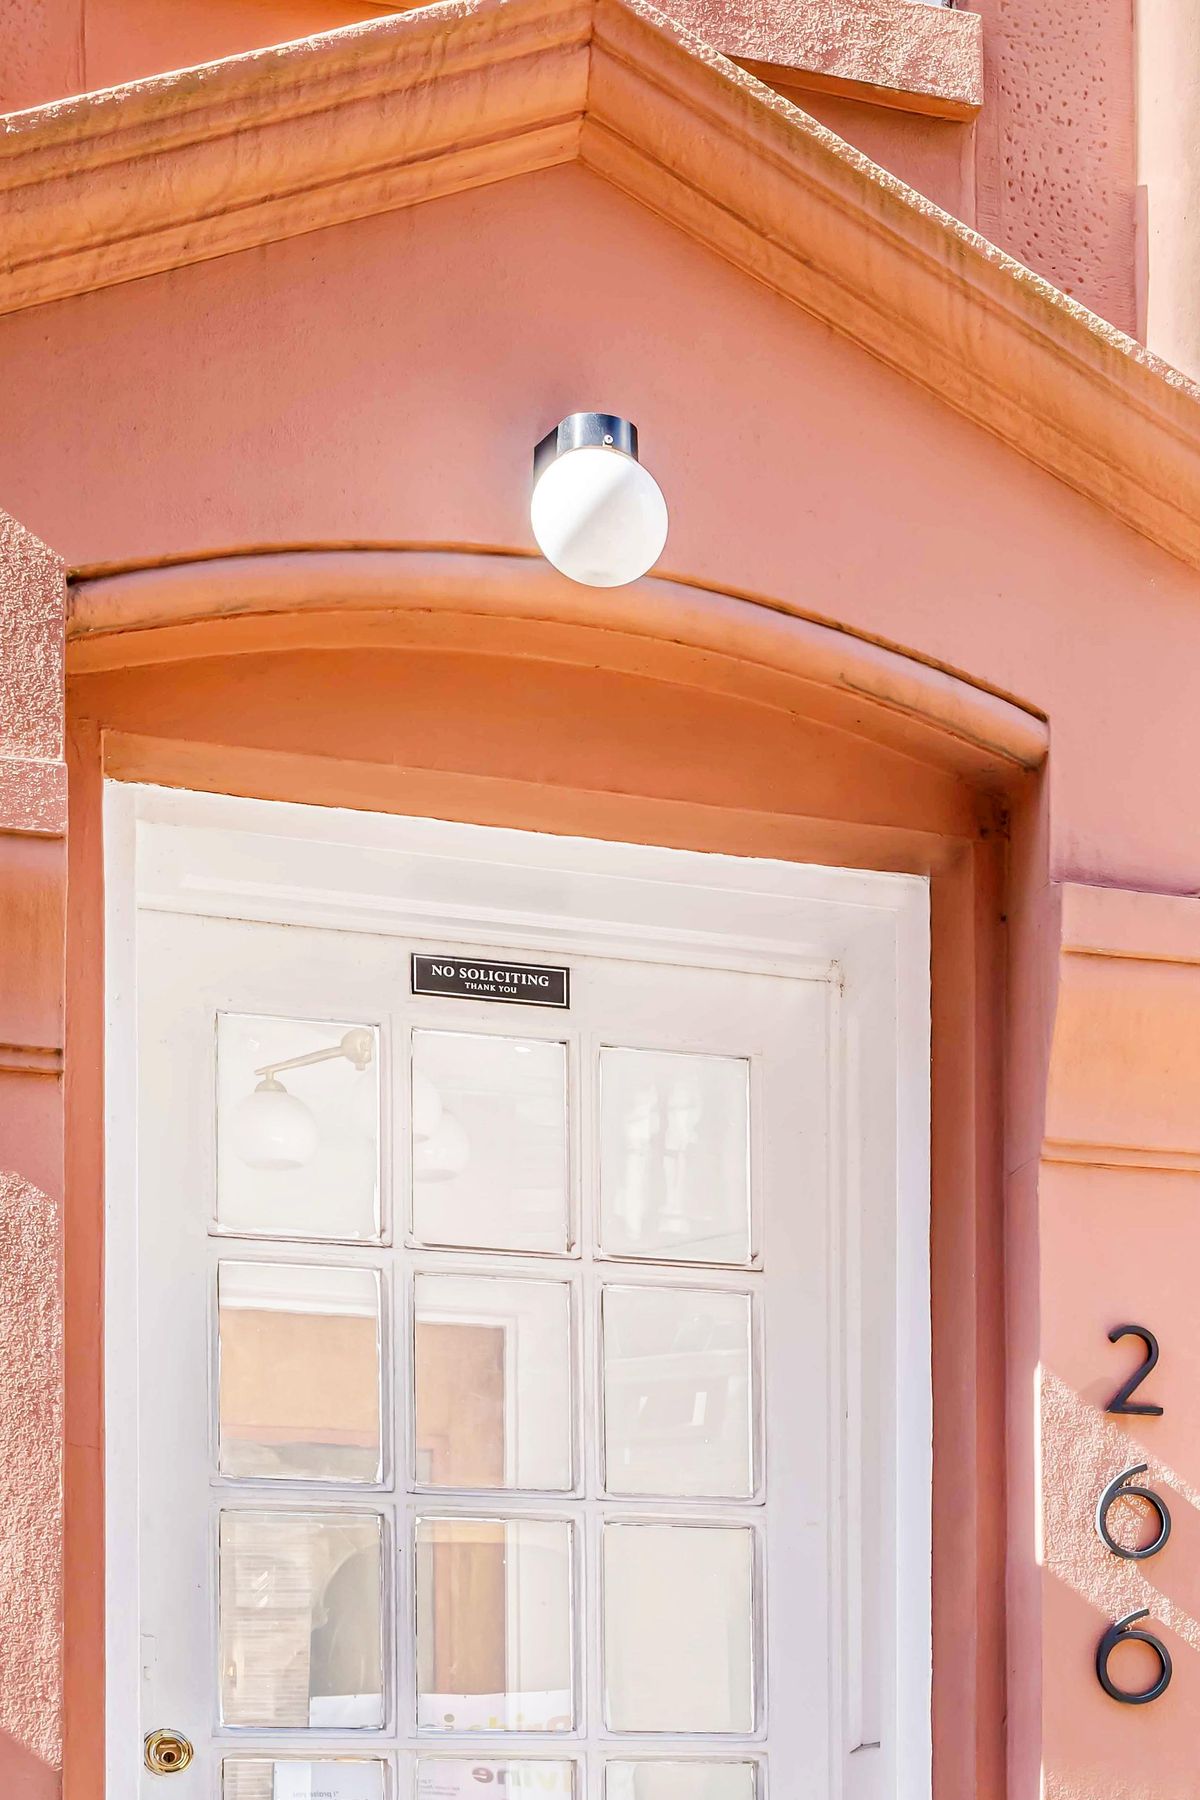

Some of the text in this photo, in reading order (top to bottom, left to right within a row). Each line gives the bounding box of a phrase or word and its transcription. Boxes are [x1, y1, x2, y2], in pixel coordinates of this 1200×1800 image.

[432, 964, 549, 987] NO SOLICITING
[465, 982, 517, 994] THANK YOU
[1095, 1324, 1172, 1705] 266
